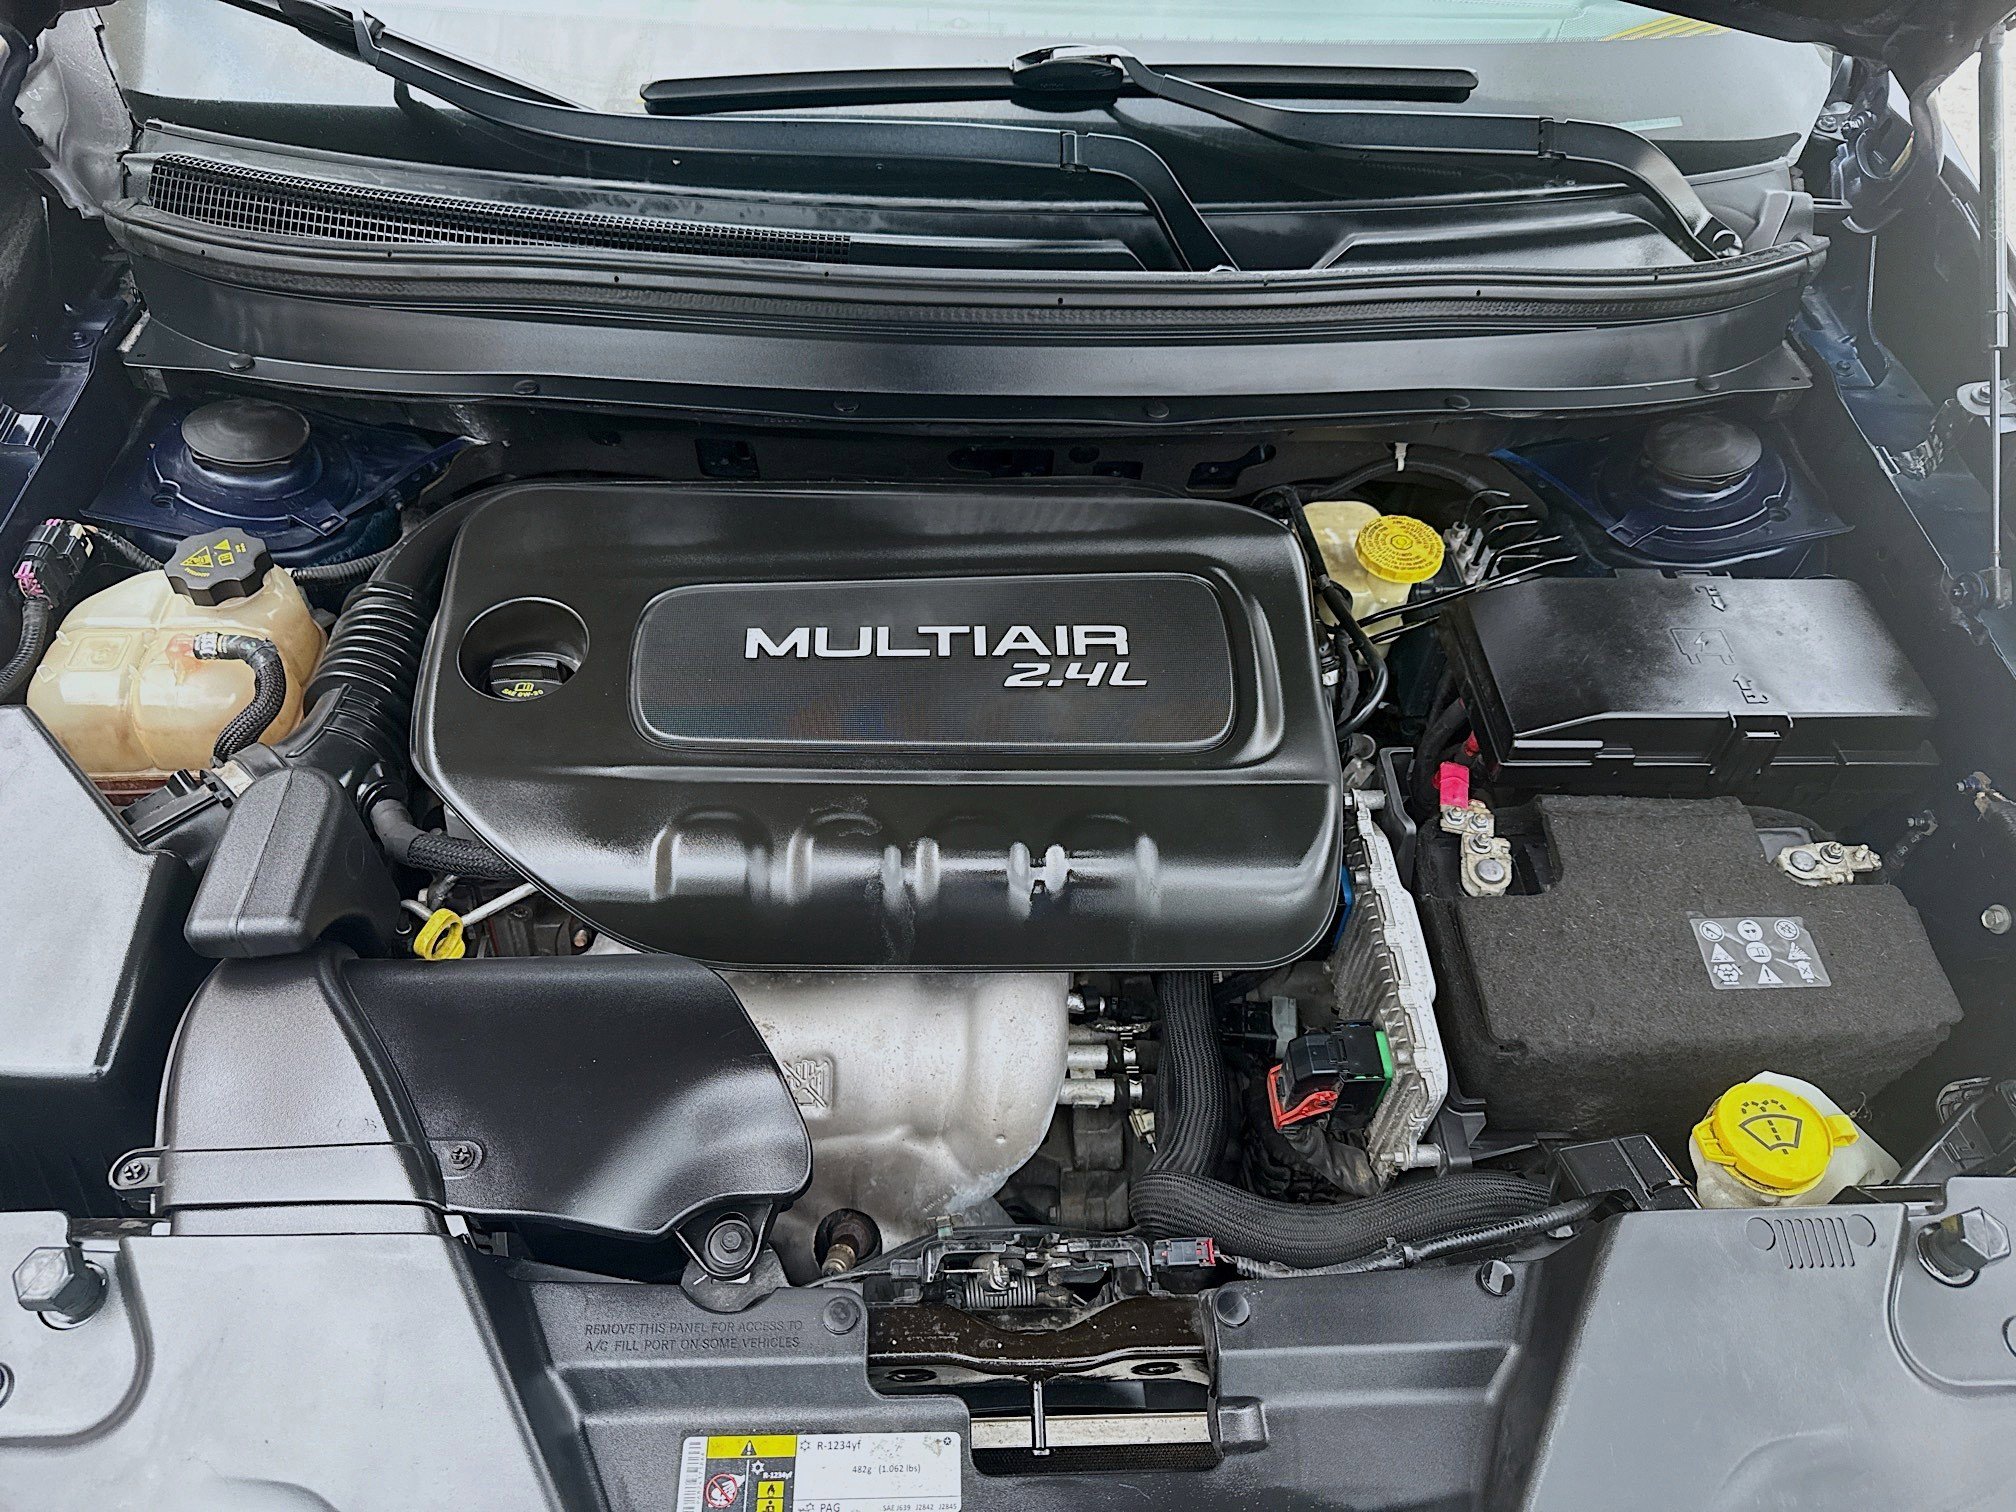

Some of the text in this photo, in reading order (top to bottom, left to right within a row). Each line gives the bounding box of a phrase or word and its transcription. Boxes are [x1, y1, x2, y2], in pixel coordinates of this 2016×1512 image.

[744, 625, 1129, 658] MULTIAIR
[1003, 662, 1148, 688] 2.4L
[585, 1320, 803, 1335] REMOVE THIS PANEL FOR ACCESS TO
[584, 1336, 800, 1351] A/C FILL PORT ON SOME VEHICLES
[816, 1440, 862, 1451] R-1234yf
[851, 1464, 922, 1475] 482g (1.062 lbs)
[820, 1503, 841, 1512] PAG
[915, 1503, 934, 1511] J2842
